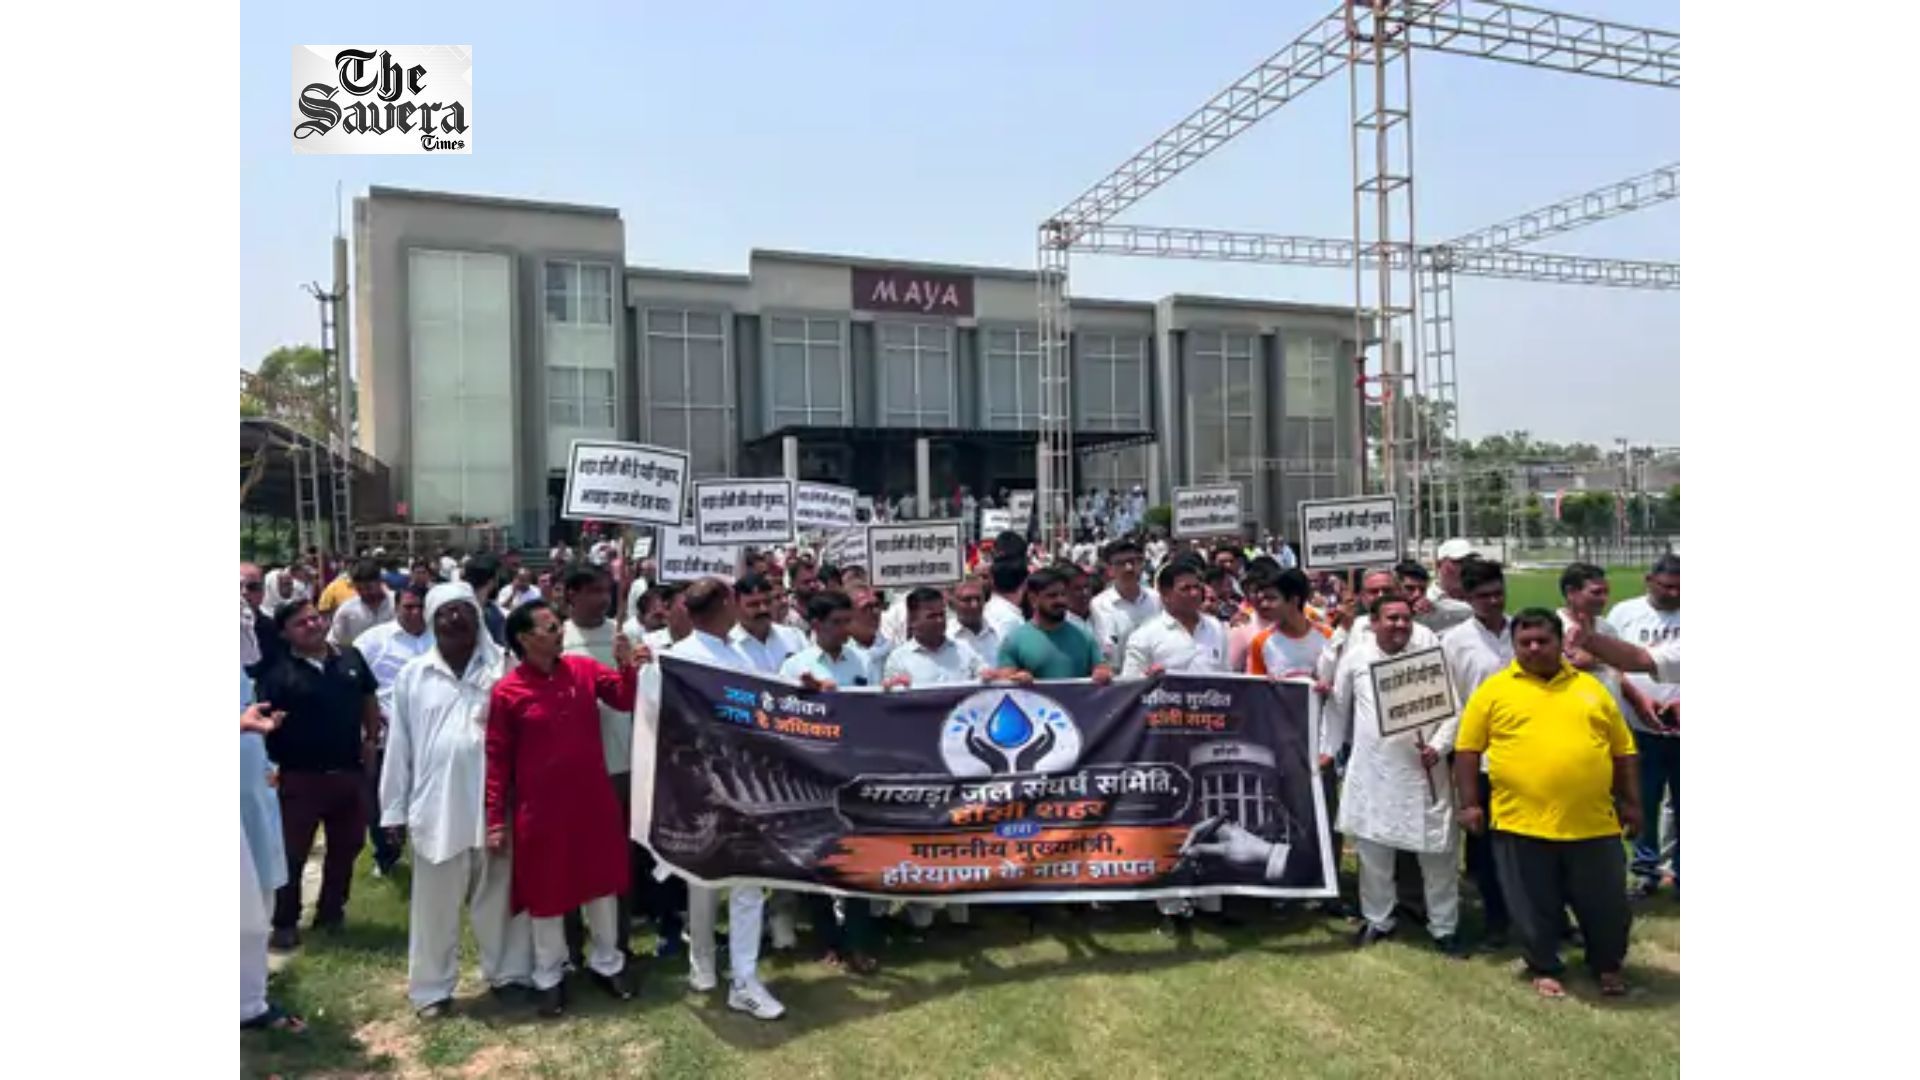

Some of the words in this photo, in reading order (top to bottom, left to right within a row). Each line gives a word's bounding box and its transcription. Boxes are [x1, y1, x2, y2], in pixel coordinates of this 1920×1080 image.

[872, 279, 958, 312] MAYA
[961, 781, 1014, 809] जल
[911, 838, 1007, 858] माननीय
[882, 861, 990, 887] हरियाणा
[1034, 861, 1079, 877] नाम
